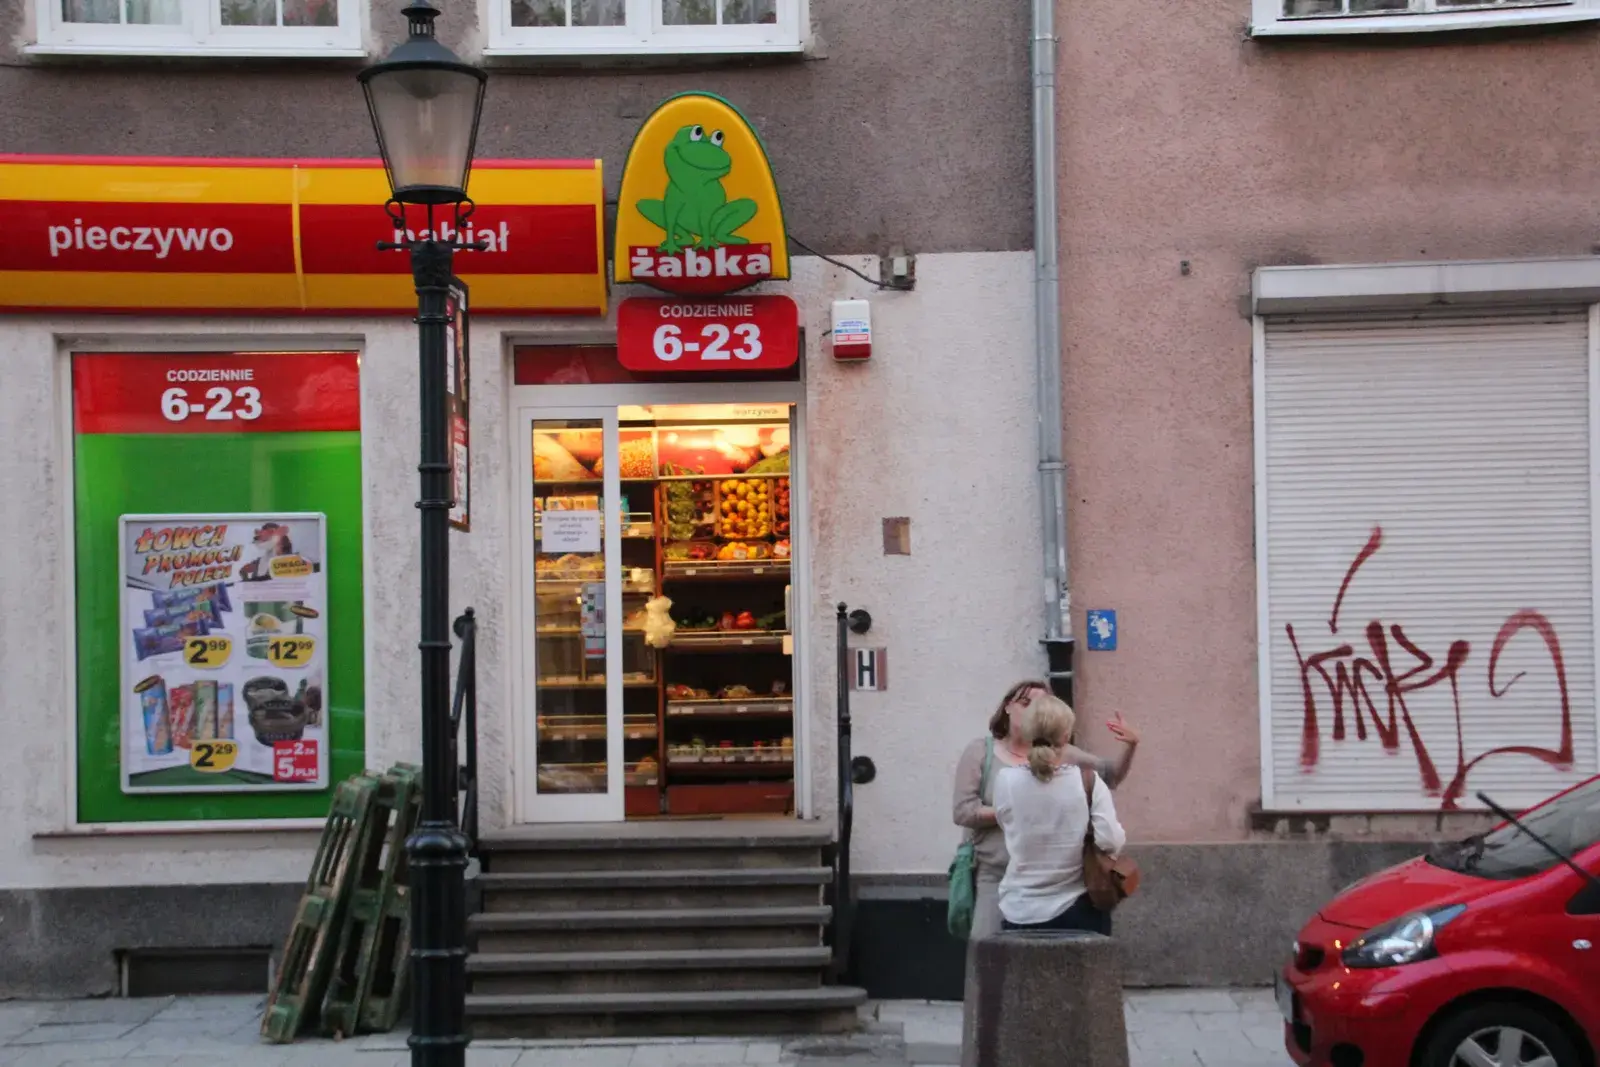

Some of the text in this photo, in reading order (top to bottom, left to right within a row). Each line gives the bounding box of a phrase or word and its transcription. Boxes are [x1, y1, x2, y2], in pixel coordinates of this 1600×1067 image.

[48, 218, 234, 259] pieczywo
[631, 247, 771, 278] żabka
[659, 303, 754, 318] CODZIENNIE
[652, 322, 763, 361] 6-23
[166, 368, 254, 382] CODZIENNIE
[160, 385, 263, 421] 6-23
[135, 524, 228, 554] ŁOWCA
[141, 544, 243, 575] PROMOCJI
[169, 564, 232, 588] POLECA
[858, 651, 875, 685] H
[278, 757, 294, 778] 5
